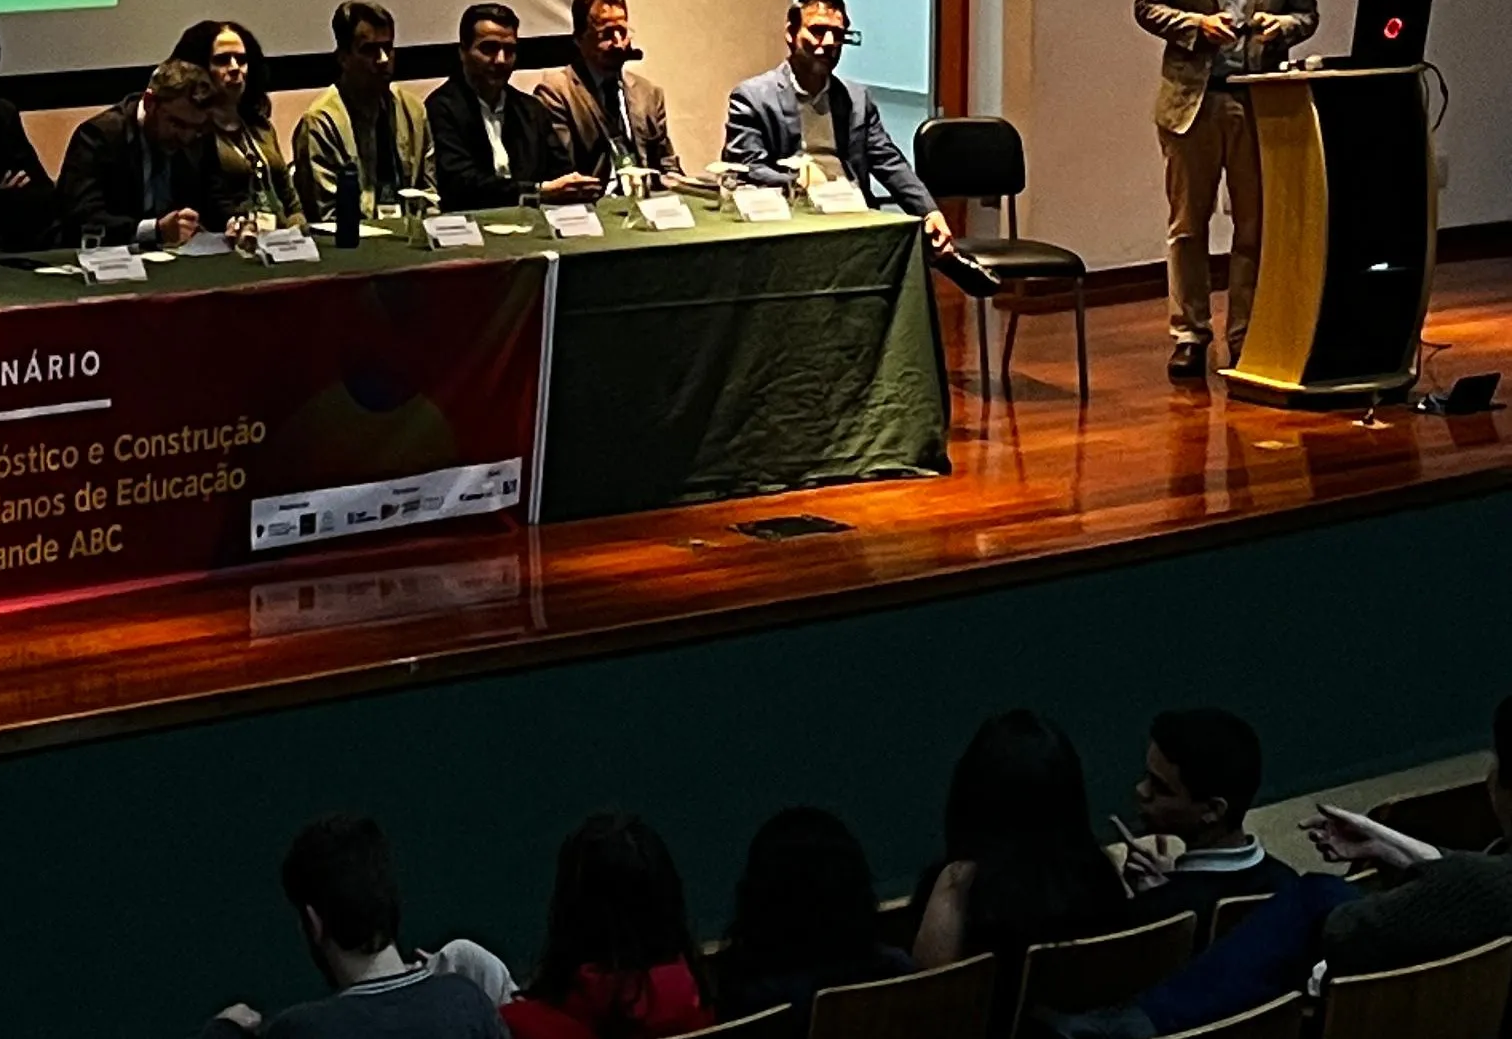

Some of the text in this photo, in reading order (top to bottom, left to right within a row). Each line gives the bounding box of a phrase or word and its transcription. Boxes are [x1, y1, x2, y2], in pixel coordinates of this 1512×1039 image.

[88, 442, 104, 465] e
[114, 418, 267, 462] Construção
[74, 481, 107, 513] de
[116, 464, 246, 508] Educação
[68, 522, 124, 560] ABC
